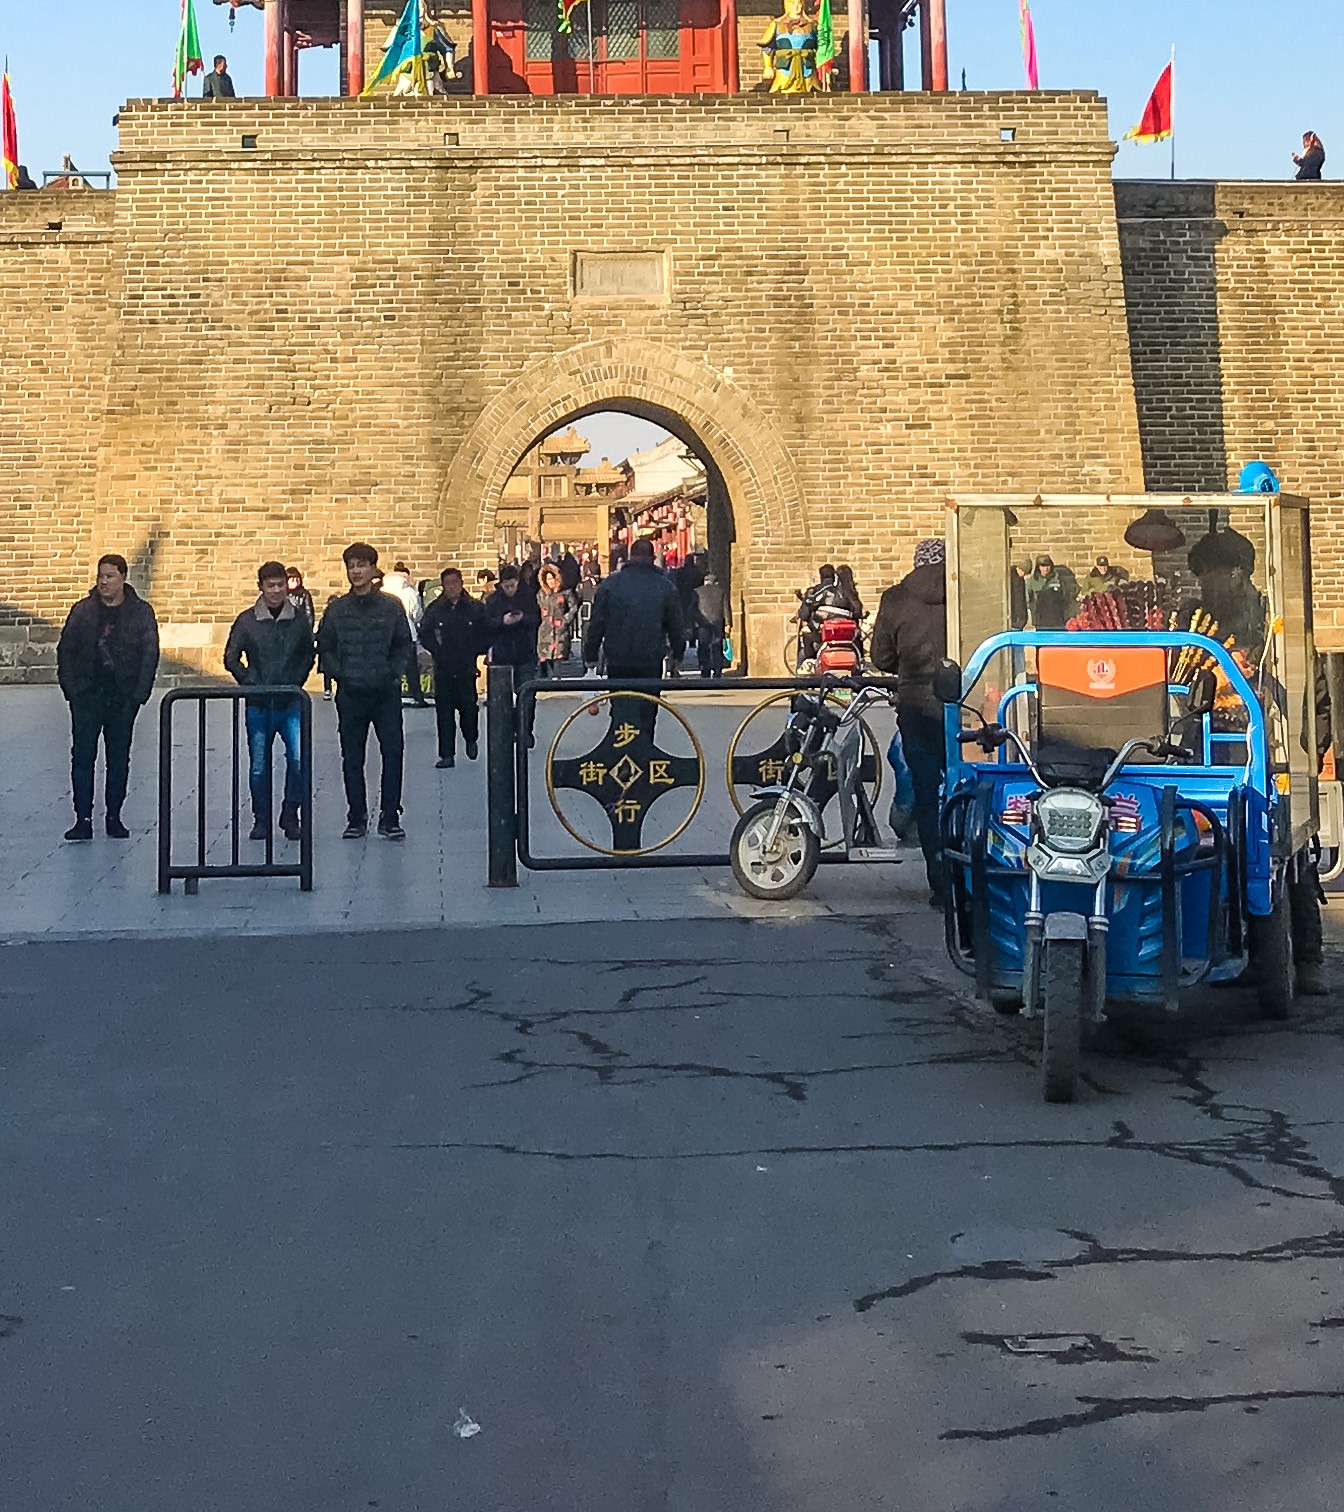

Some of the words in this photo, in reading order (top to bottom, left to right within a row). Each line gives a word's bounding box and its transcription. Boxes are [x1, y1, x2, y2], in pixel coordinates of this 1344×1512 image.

[612, 723, 641, 748] 步
[579, 761, 607, 786] 街
[649, 759, 675, 785] 区
[758, 759, 784, 784] 街
[614, 799, 642, 823] 行
